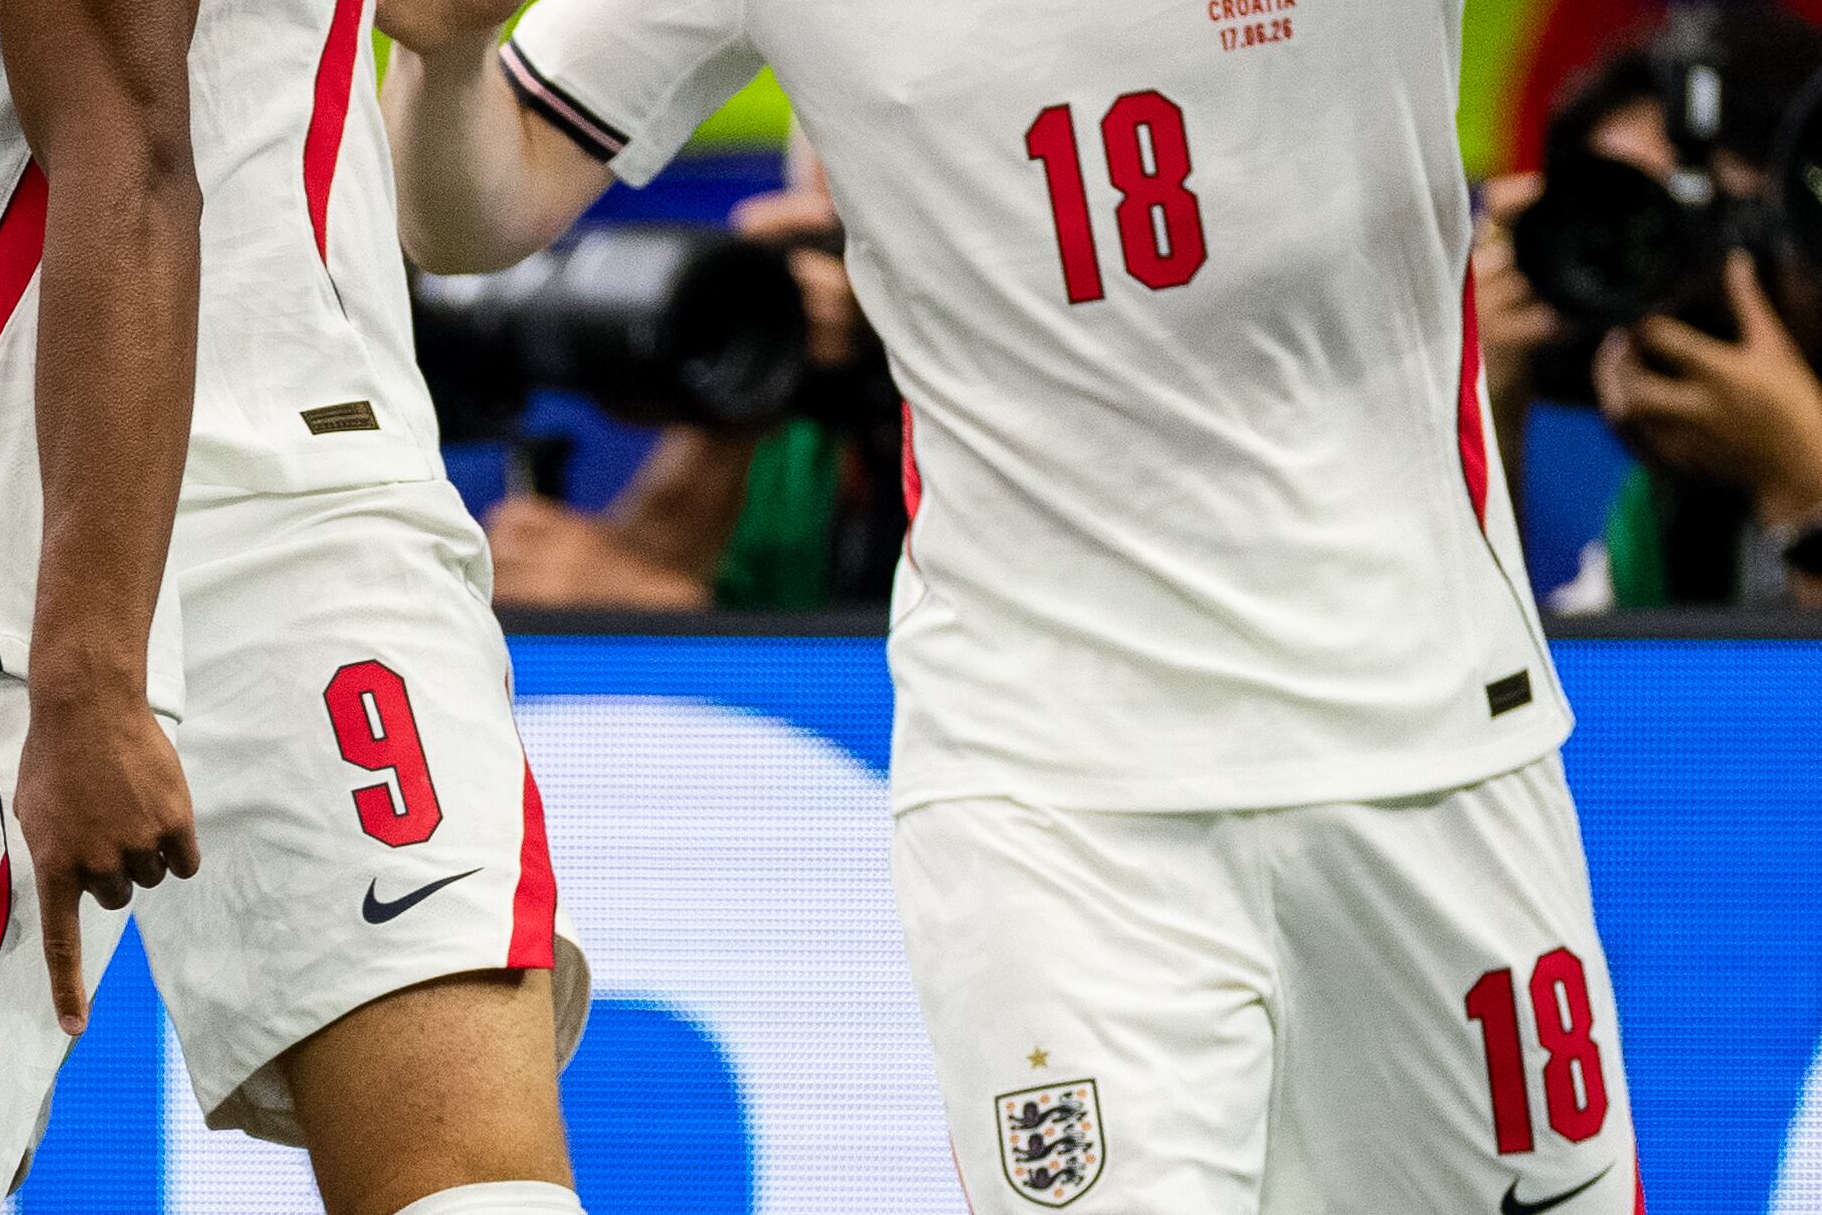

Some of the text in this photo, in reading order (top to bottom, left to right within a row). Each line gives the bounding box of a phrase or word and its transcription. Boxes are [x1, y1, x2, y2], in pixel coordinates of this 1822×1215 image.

[1025, 90, 1208, 303] 18
[323, 659, 443, 850] 9
[1467, 947, 1611, 1155] 18
